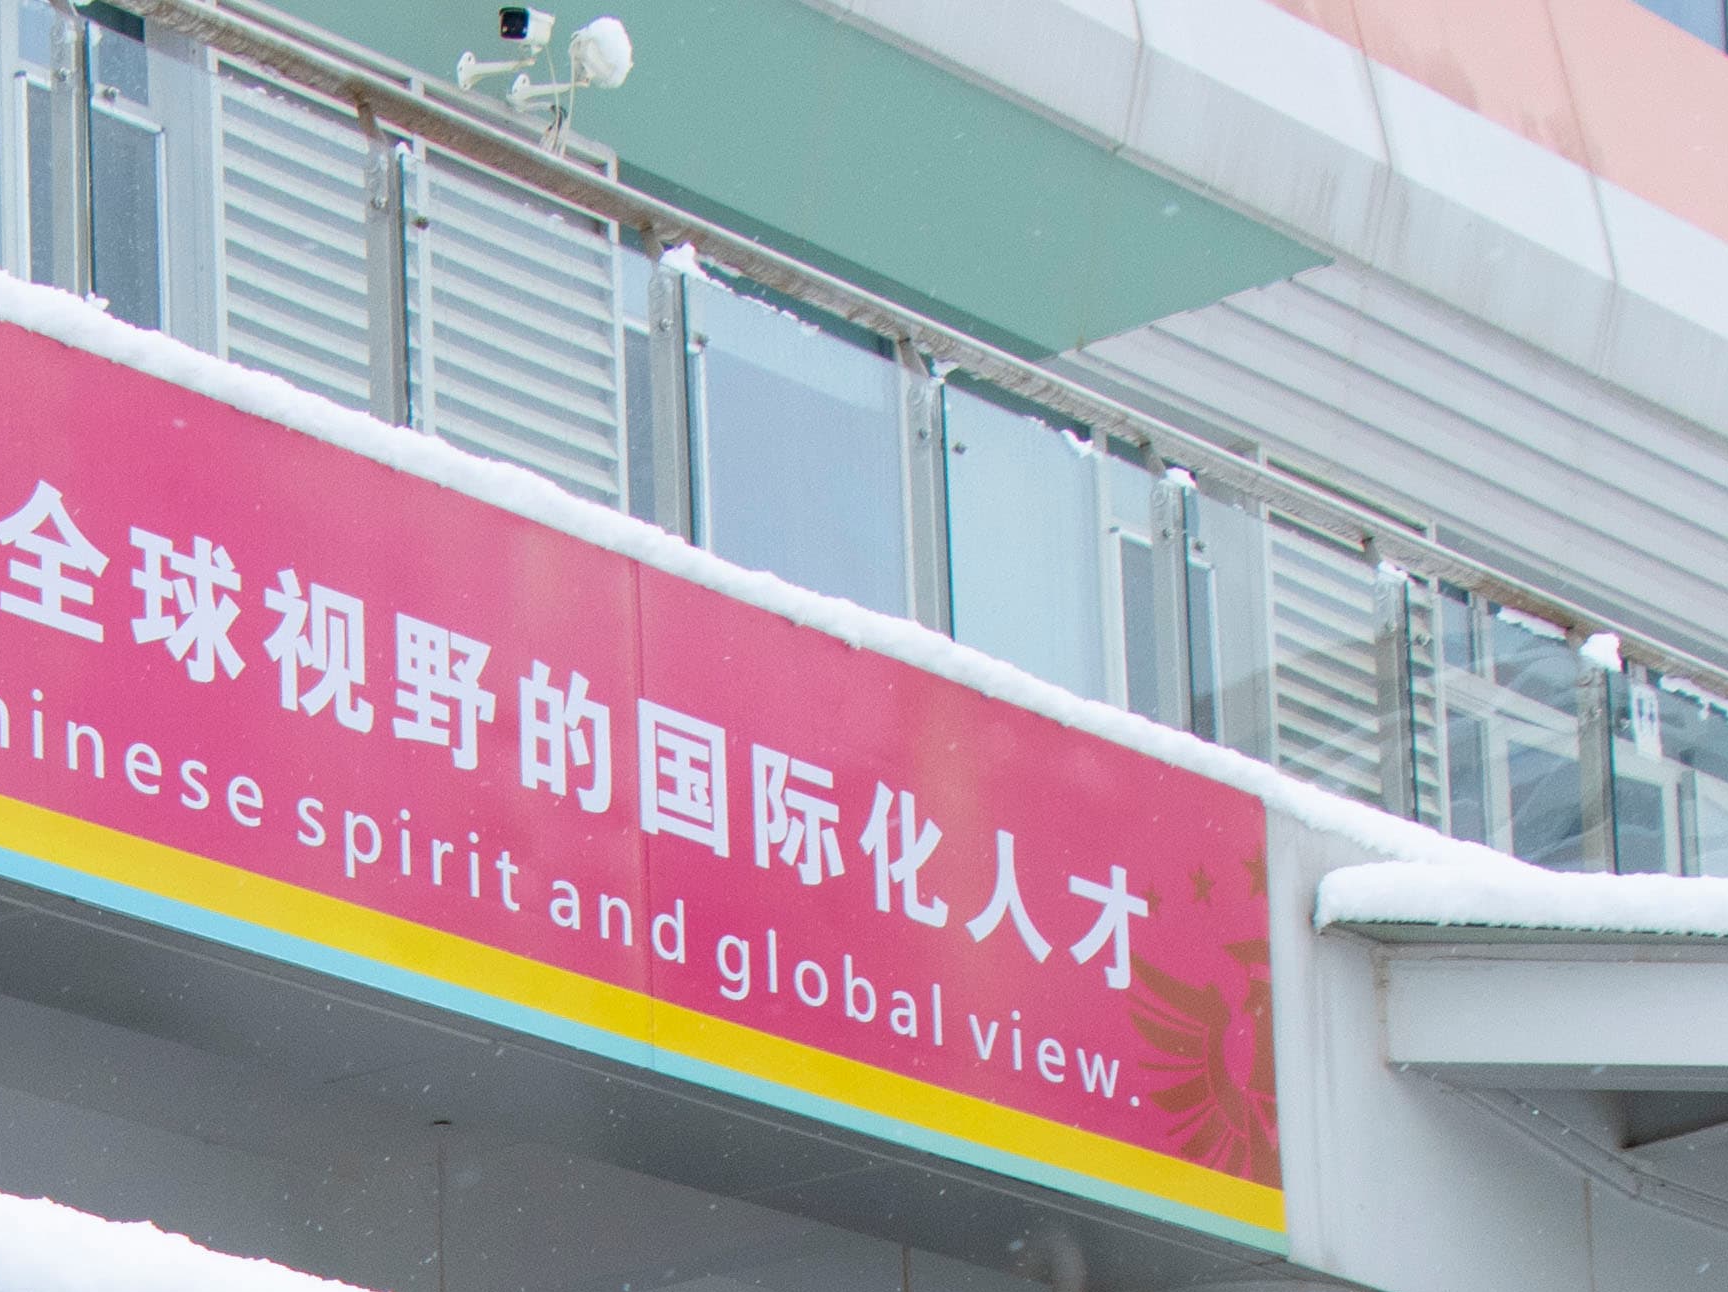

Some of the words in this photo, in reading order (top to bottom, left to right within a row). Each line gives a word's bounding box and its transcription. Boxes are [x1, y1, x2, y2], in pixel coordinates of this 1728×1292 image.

[298, 800, 525, 912] spirit
[548, 872, 692, 965] and
[717, 930, 947, 1048] global
[972, 1010, 1144, 1106] view.
